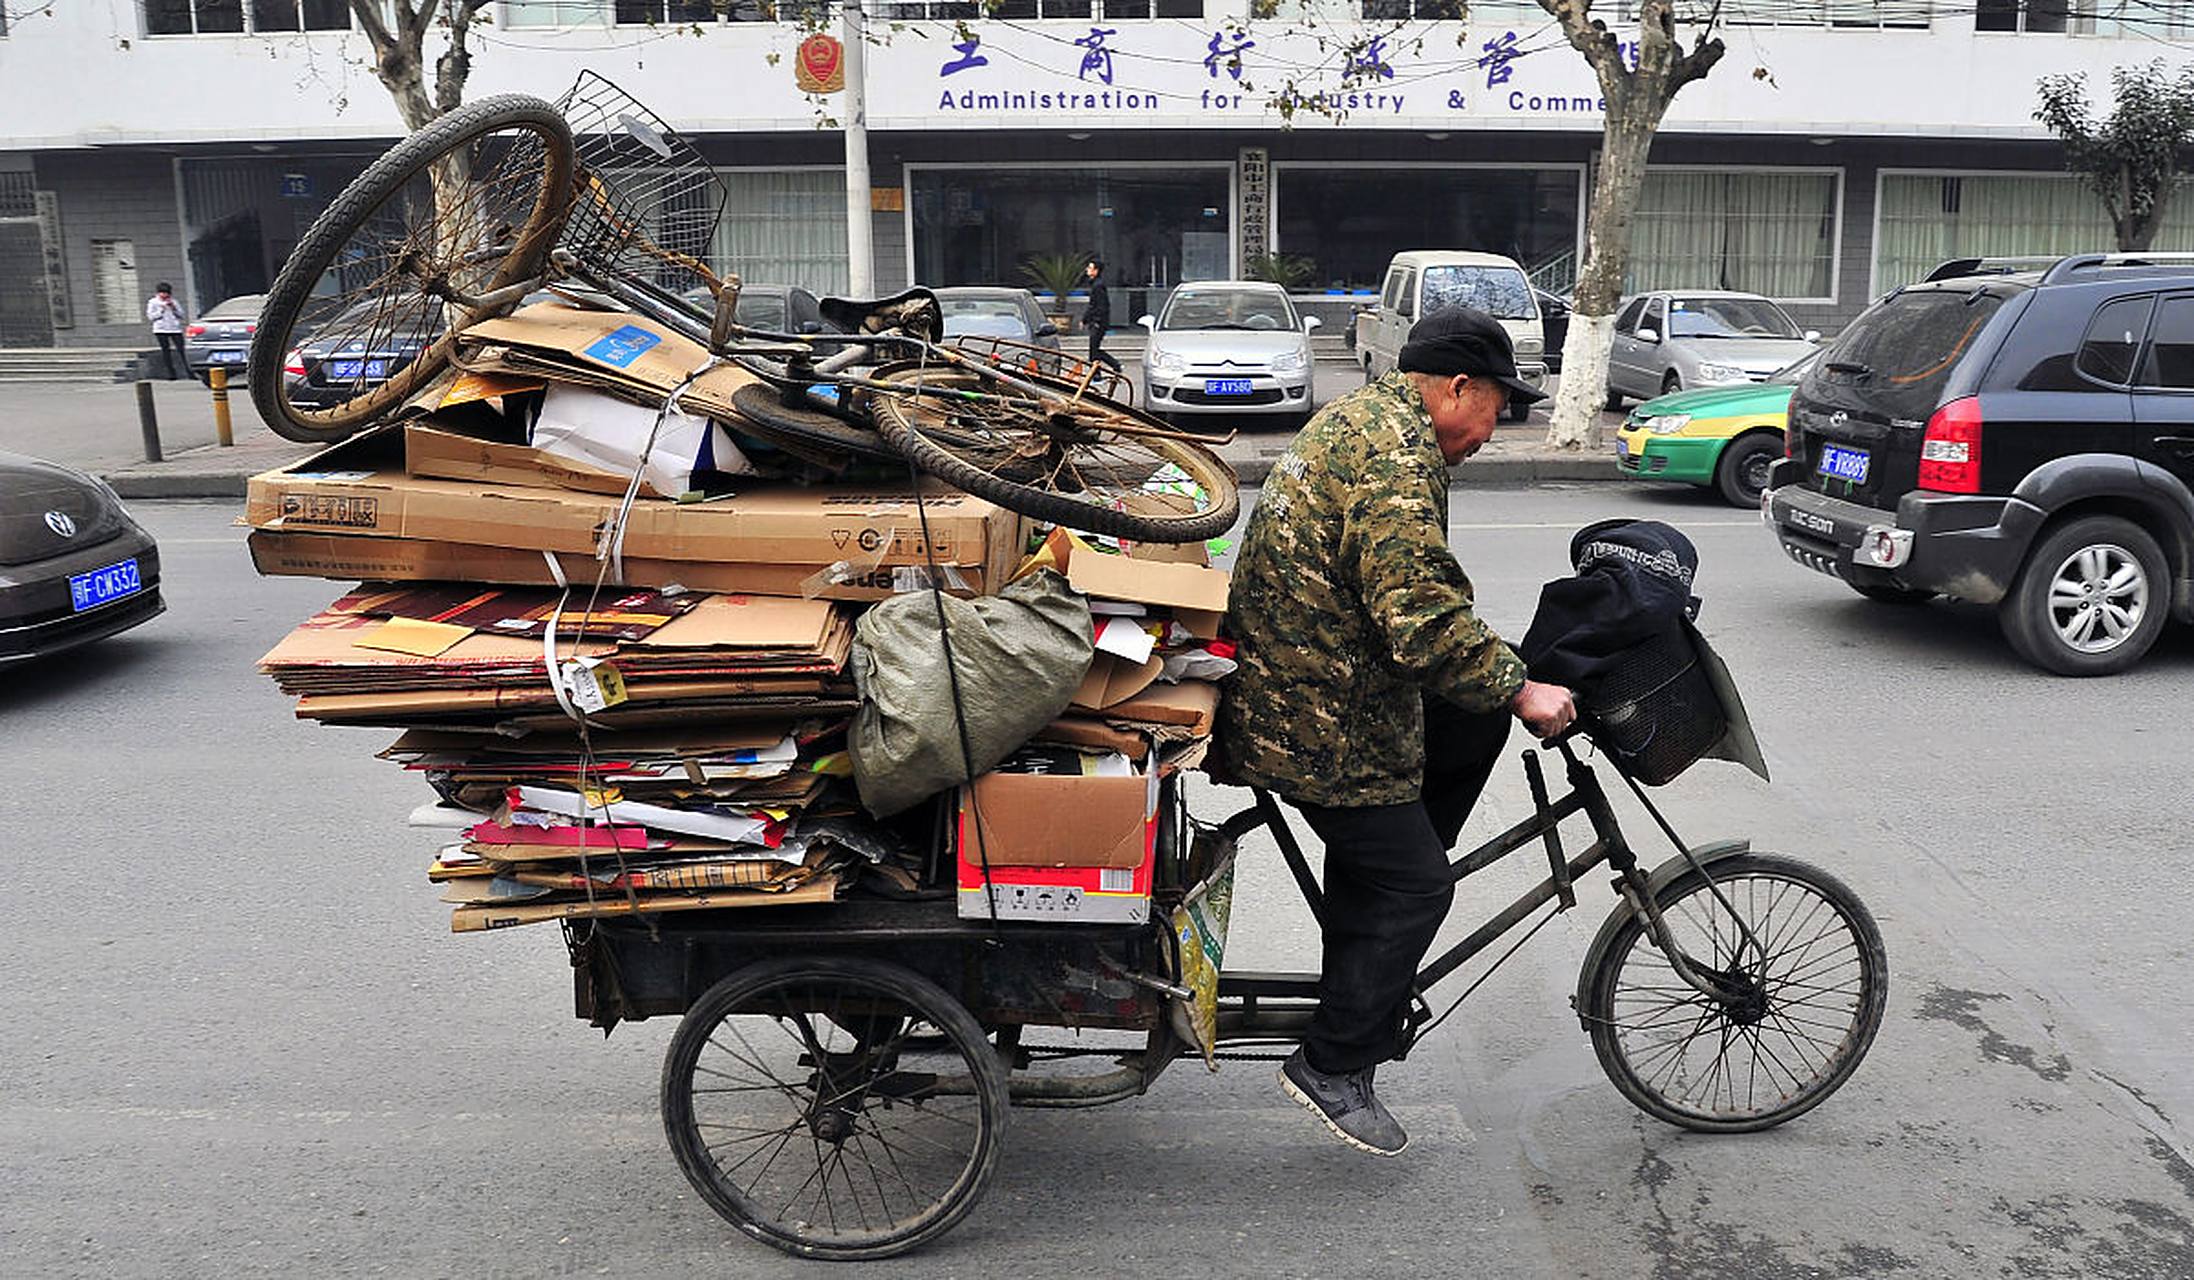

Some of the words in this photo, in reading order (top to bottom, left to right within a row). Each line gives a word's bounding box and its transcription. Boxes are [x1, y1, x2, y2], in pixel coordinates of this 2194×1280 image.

[939, 90, 1158, 110] Administration
[1201, 90, 1242, 110] for
[1448, 90, 1464, 109] &
